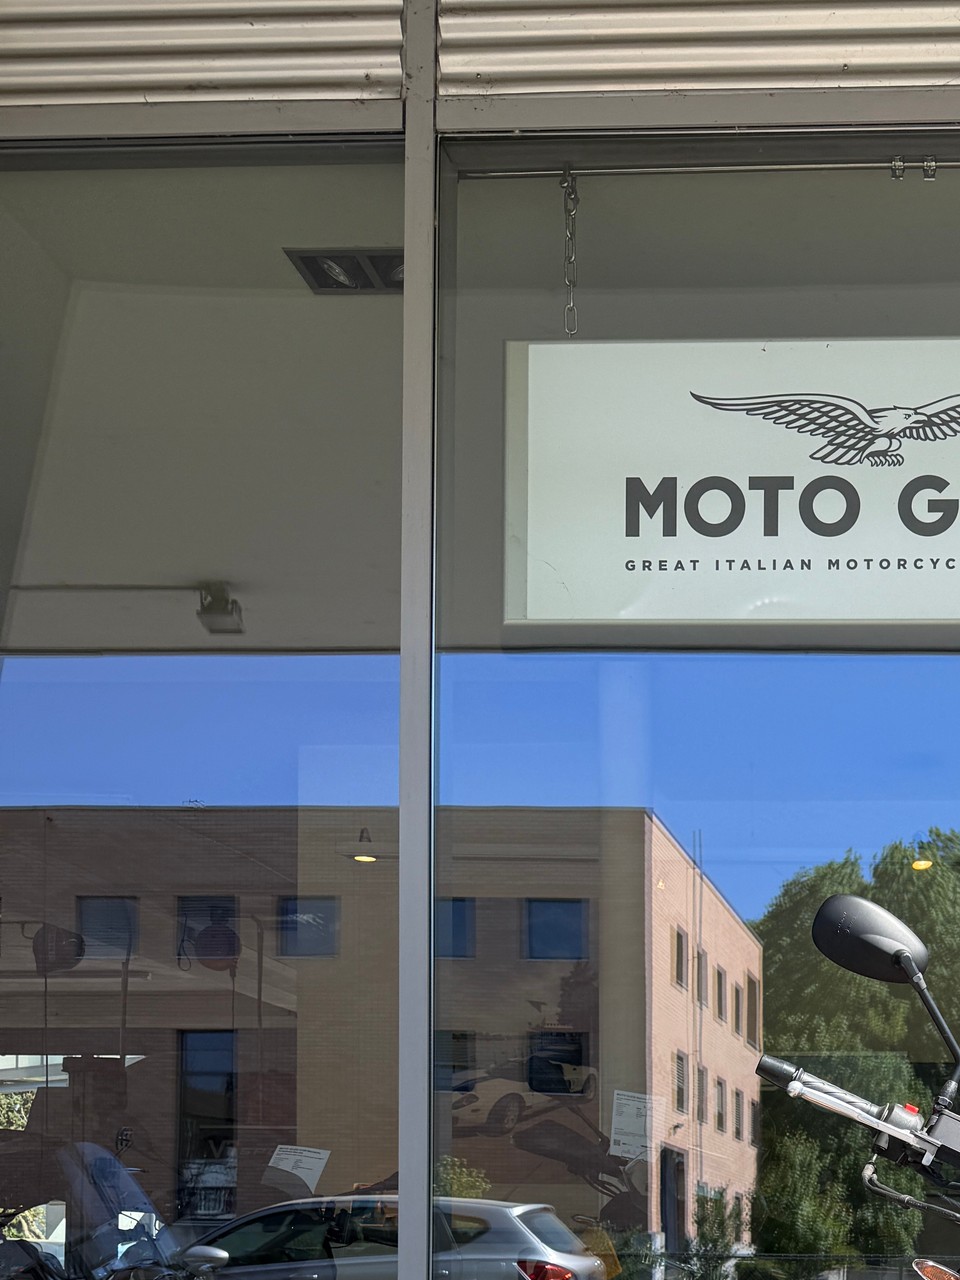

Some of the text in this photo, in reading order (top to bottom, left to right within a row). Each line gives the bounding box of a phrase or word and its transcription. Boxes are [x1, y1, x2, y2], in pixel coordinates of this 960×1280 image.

[625, 475, 861, 538] MOTO
[625, 559, 700, 572] GREAT
[715, 558, 812, 571] ITALIAN
